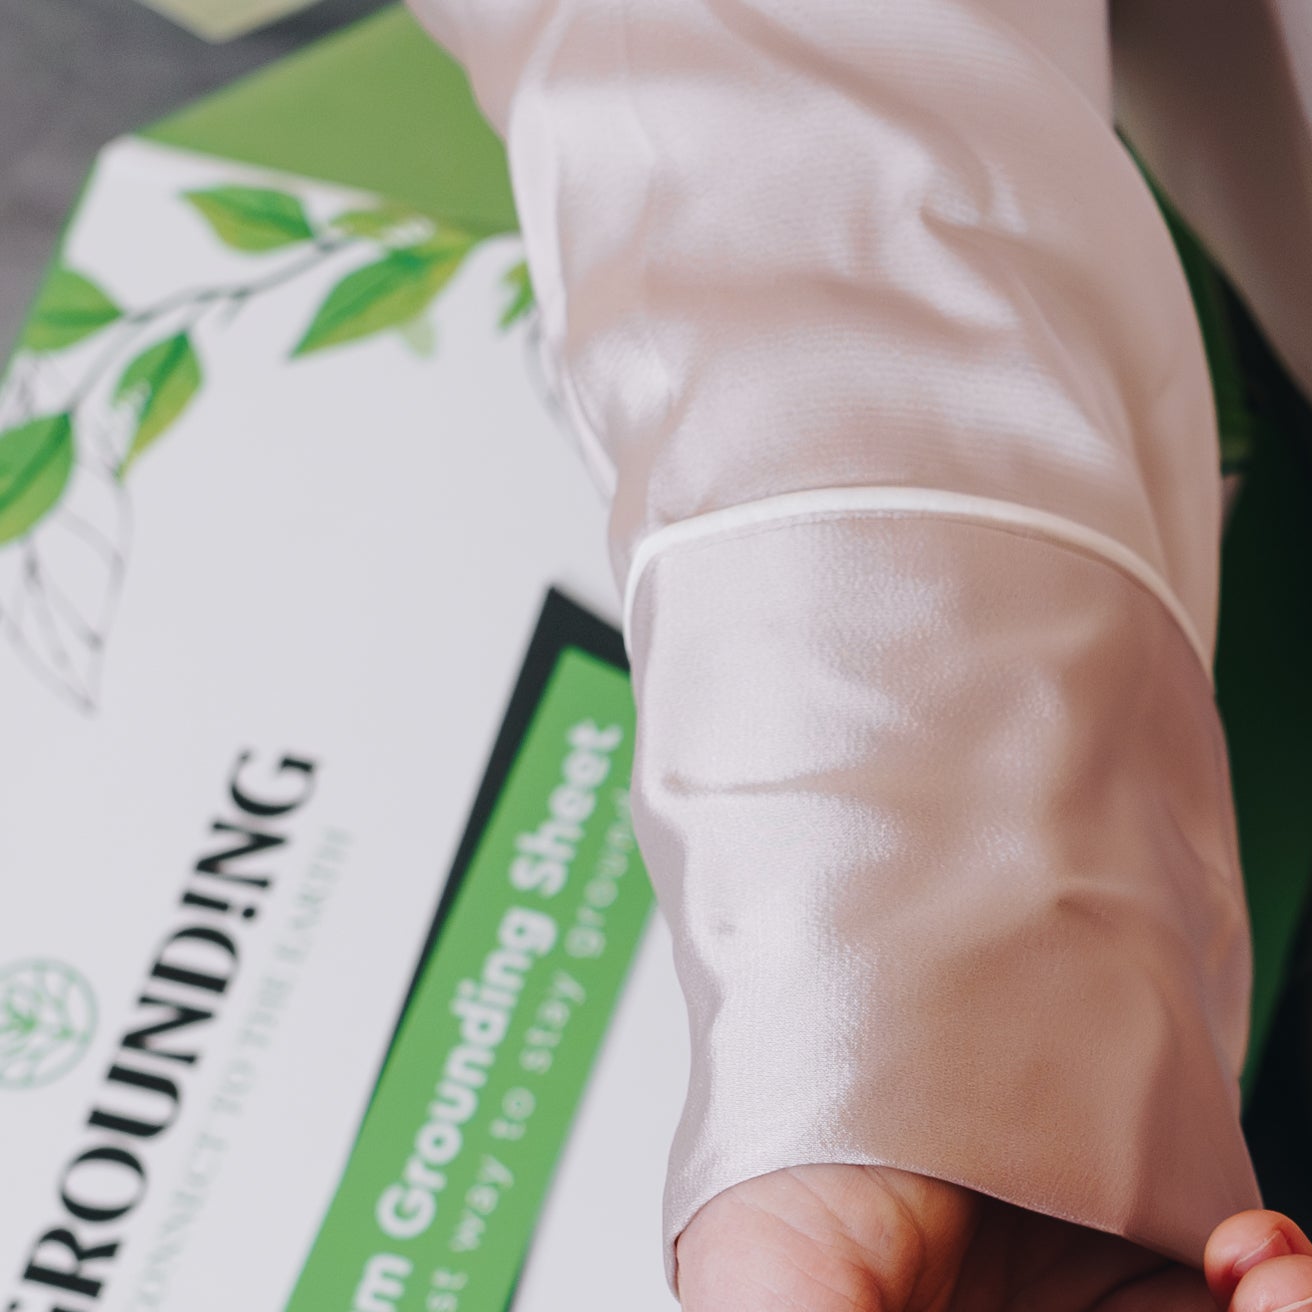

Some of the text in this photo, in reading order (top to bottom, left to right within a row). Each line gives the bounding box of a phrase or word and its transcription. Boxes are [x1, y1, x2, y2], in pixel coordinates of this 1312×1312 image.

[377, 905, 558, 1240] Grounding
[509, 716, 624, 898] Sheet
[452, 1154, 514, 1253] way
[491, 1086, 538, 1140] to
[519, 968, 587, 1076] stay
